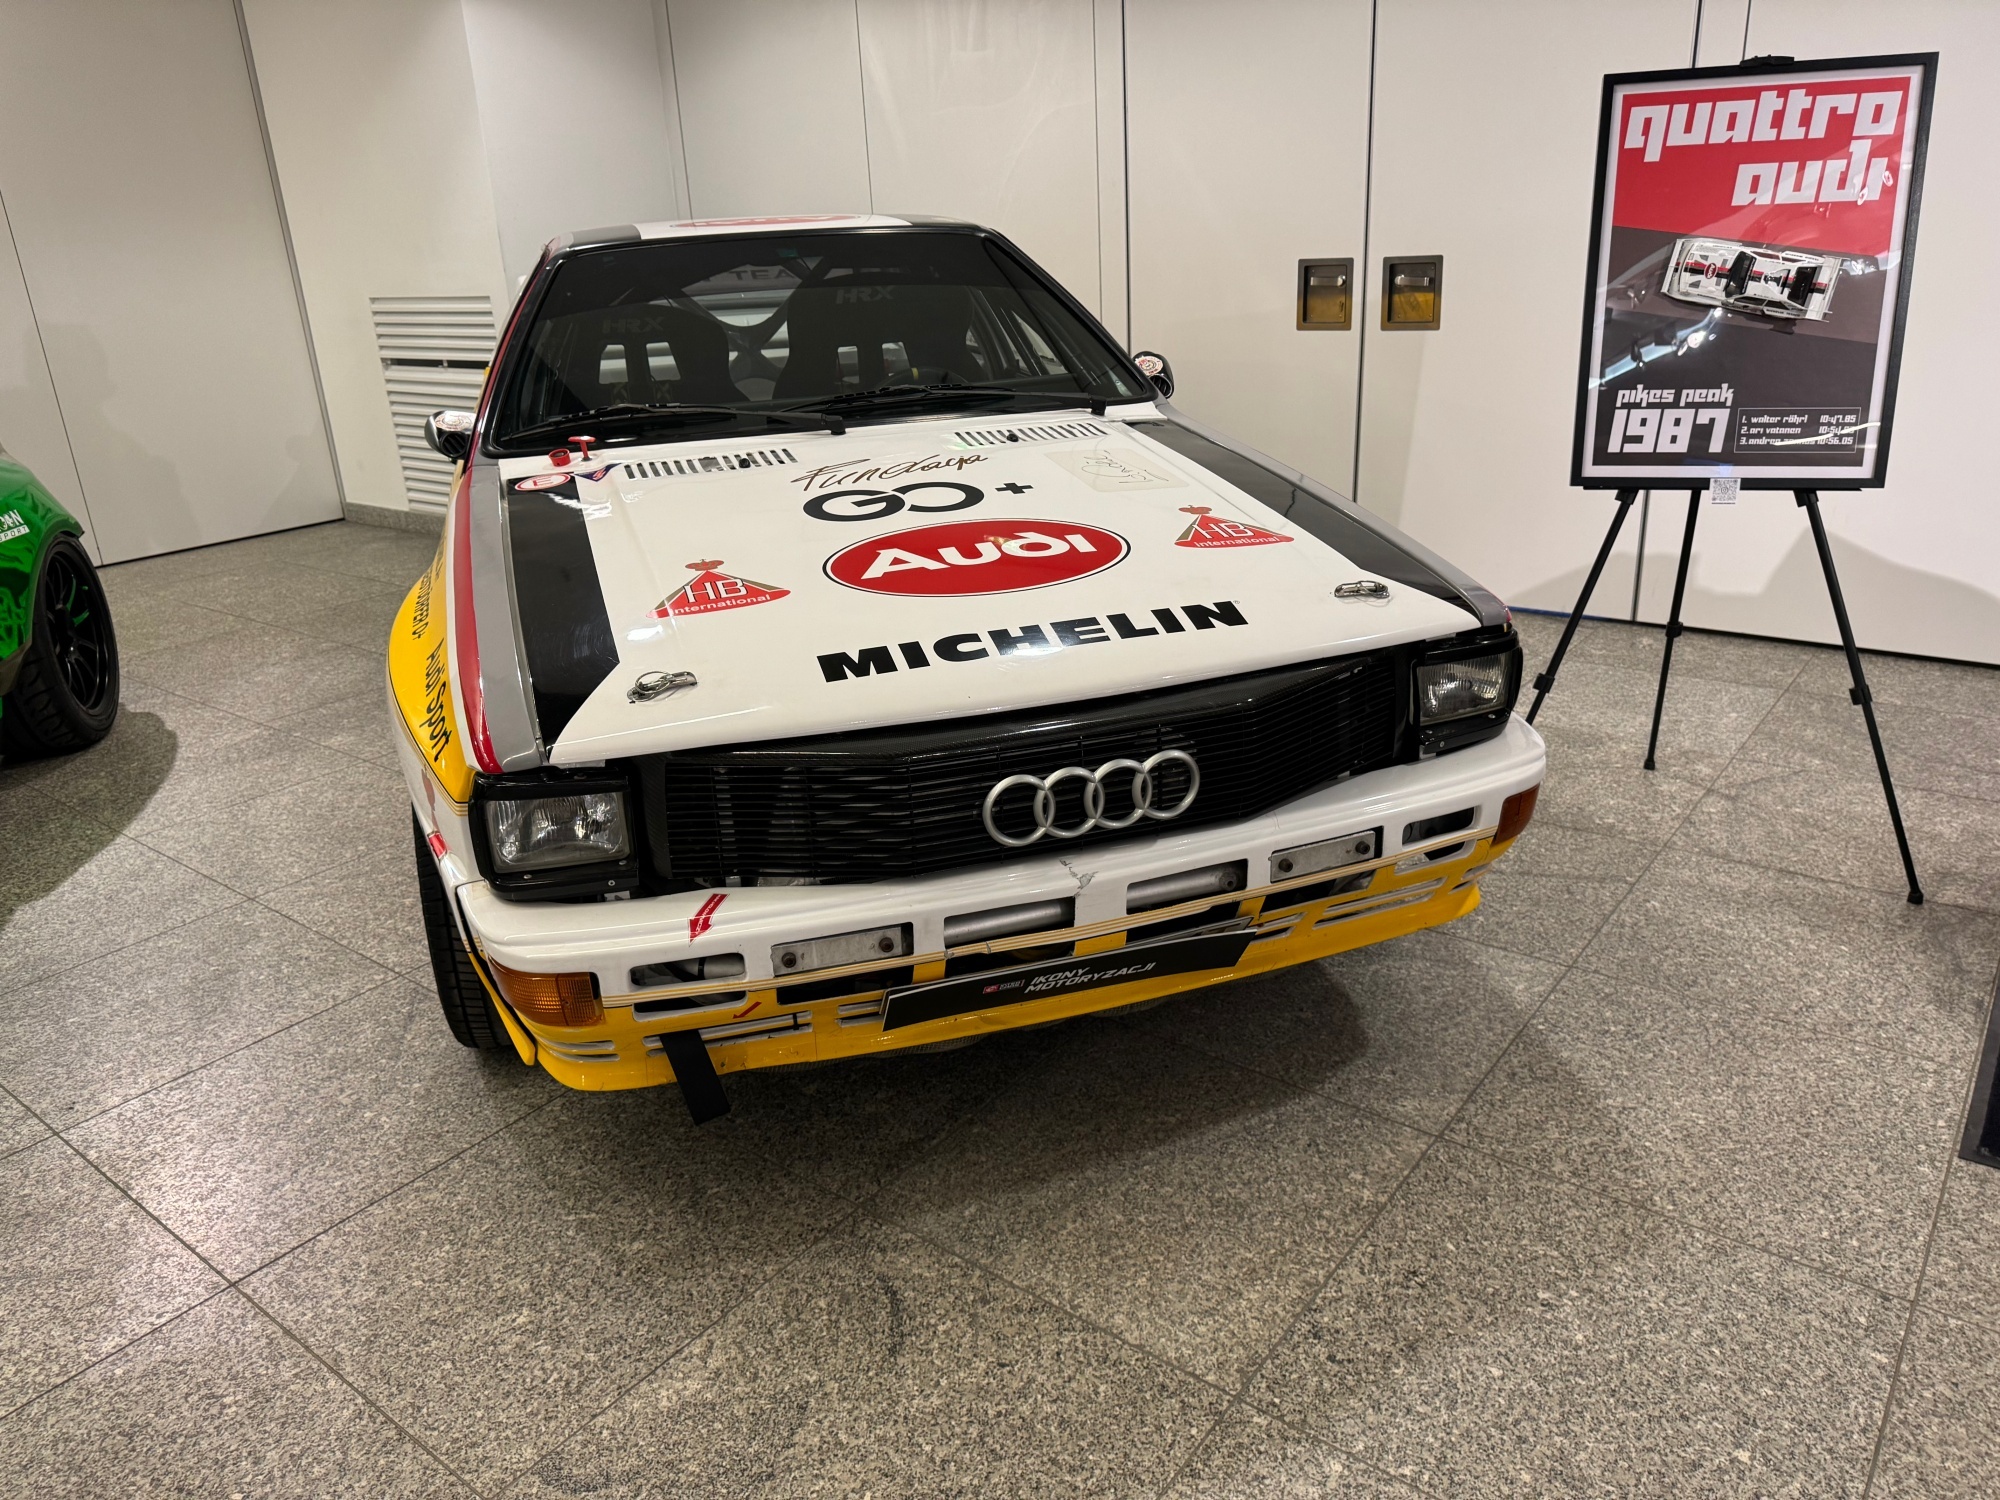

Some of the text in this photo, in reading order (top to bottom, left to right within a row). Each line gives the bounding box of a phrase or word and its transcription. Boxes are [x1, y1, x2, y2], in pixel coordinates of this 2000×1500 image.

[1624, 89, 1903, 162] quattro
[1731, 139, 1888, 206] audi
[836, 285, 896, 304] HRX
[602, 316, 665, 334] HRX
[1615, 383, 1734, 407] pikes peak
[1607, 408, 1731, 453] 1987
[1750, 414, 1782, 424] walter
[1192, 522, 1255, 539] HB
[860, 531, 1098, 580] Audi
[683, 578, 748, 604] HB
[816, 600, 1249, 683] MICHELIN
[418, 637, 453, 763] Audi Sport
[1024, 962, 1157, 994] MOTORYZACJI
[1030, 966, 1091, 986] IKONY
